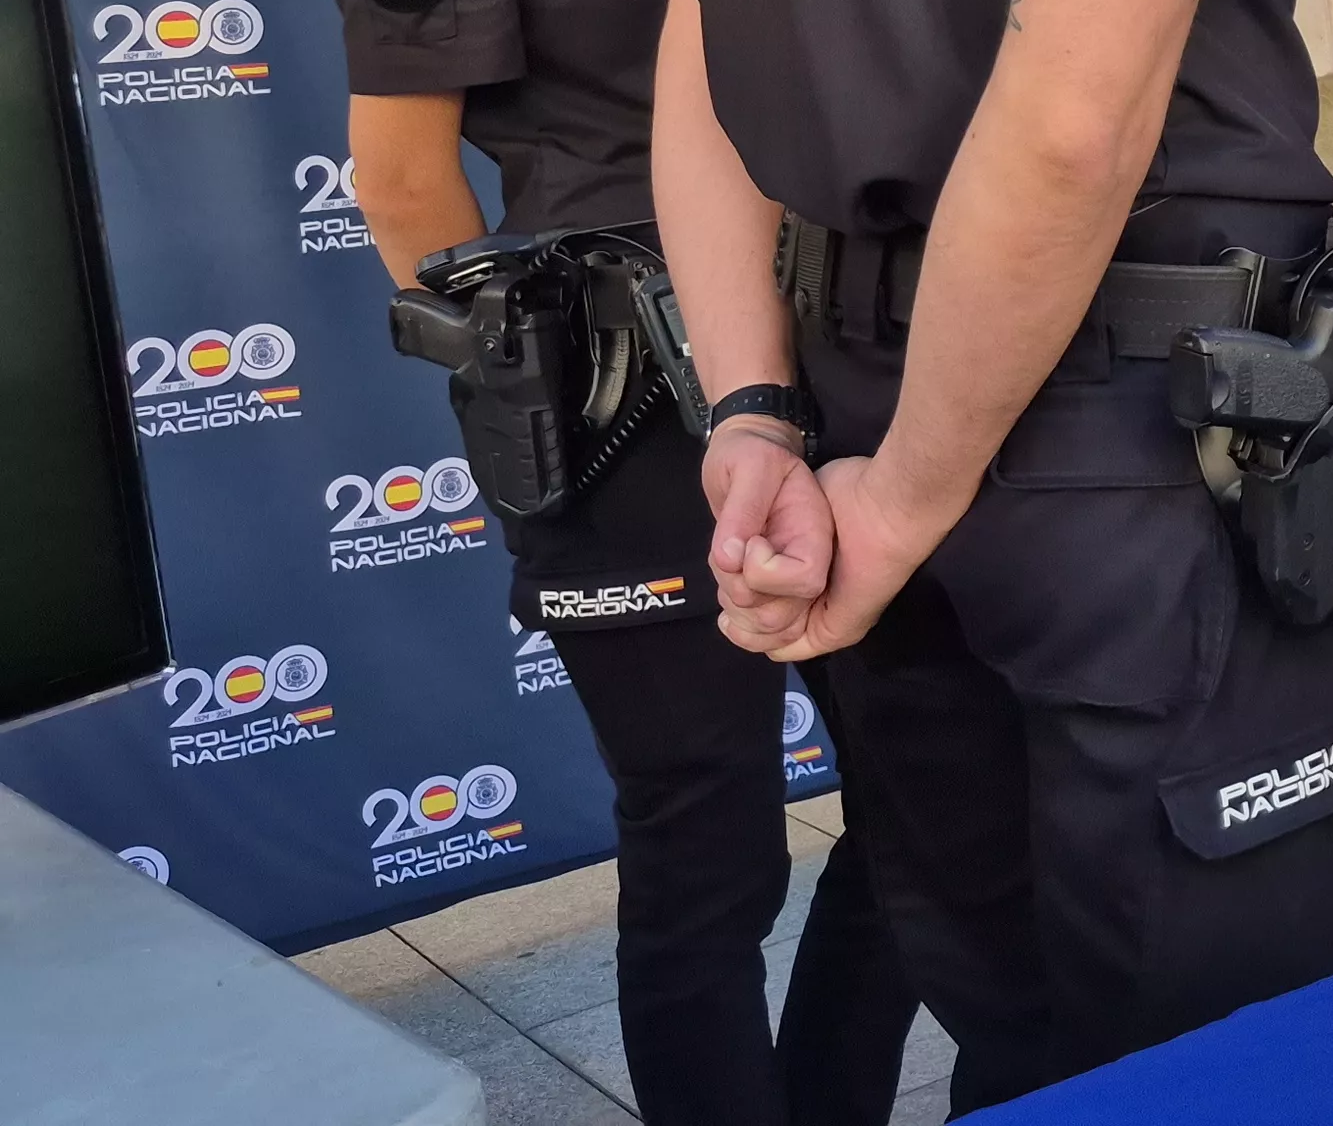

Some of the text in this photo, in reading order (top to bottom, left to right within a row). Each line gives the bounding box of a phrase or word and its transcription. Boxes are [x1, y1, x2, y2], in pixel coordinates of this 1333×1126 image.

[99, 80, 272, 107] NACIONAL
[331, 535, 487, 572] NACIONAL
[541, 593, 687, 620] NACIONAL
[171, 727, 336, 767] NACIONAL
[374, 839, 528, 888] NACIONAL
